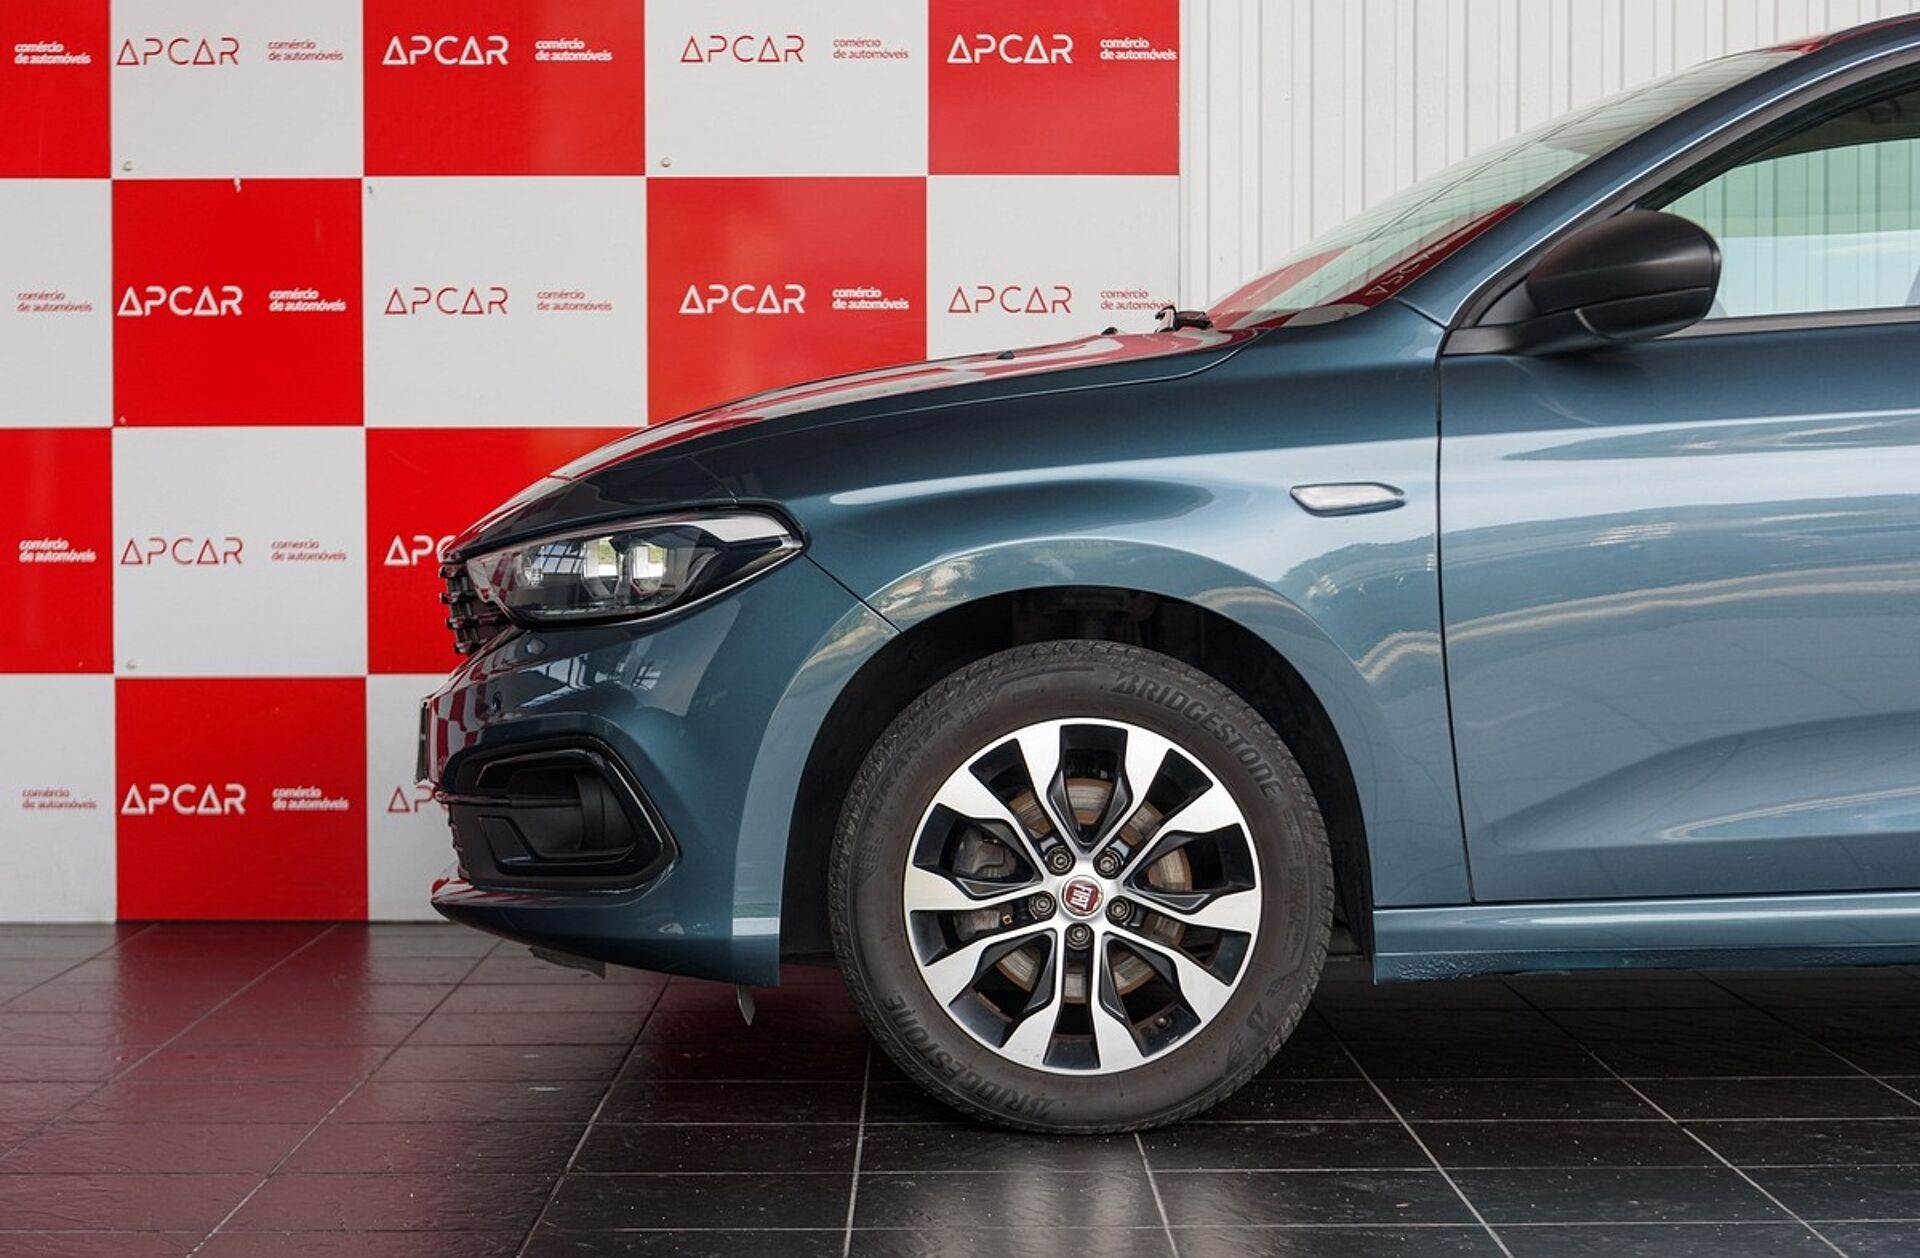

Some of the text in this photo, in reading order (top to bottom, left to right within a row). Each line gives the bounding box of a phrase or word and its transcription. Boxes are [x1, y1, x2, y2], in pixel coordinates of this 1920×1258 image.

[14, 41, 64, 52] comércio
[268, 39, 316, 49] comércio
[535, 38, 584, 49] comércio
[833, 38, 881, 47] comércio
[1100, 37, 1149, 48] comércio
[116, 37, 239, 65] APCAR
[382, 35, 509, 65] APCAR
[680, 35, 804, 63] APCAR
[833, 49, 909, 59] de automóveis
[947, 34, 1073, 64] APCAR
[1100, 49, 1177, 60] de automóveis
[14, 53, 91, 64] de automóveis
[268, 50, 344, 61] de automóveis
[535, 50, 612, 61] de automóveis
[17, 290, 65, 300] comércio
[269, 288, 318, 300] comércio
[537, 289, 585, 299] comércio
[832, 287, 881, 298] comércio
[1100, 288, 1149, 298] comércio
[117, 286, 243, 316] APCAR
[385, 287, 508, 315] APCAR
[680, 284, 805, 314] APCAR
[832, 298, 909, 309] de automóveis
[948, 286, 1072, 313] APCAR
[1100, 299, 1113, 310] de
[17, 302, 92, 311] de automóveis
[269, 300, 346, 311] de automóveis
[537, 301, 612, 311] de automóveis
[19, 538, 69, 550] comércio
[19, 550, 96, 562] de automóveis
[120, 537, 243, 565] APCAR
[272, 551, 284, 561] de
[1111, 671, 1285, 799] BRIDGESTONE
[22, 799, 35, 809] de
[121, 784, 246, 814] APCAR
[272, 798, 286, 809] de
[1070, 884, 1093, 910] FIAT
[884, 995, 1052, 1119] BRIDGESTONE
